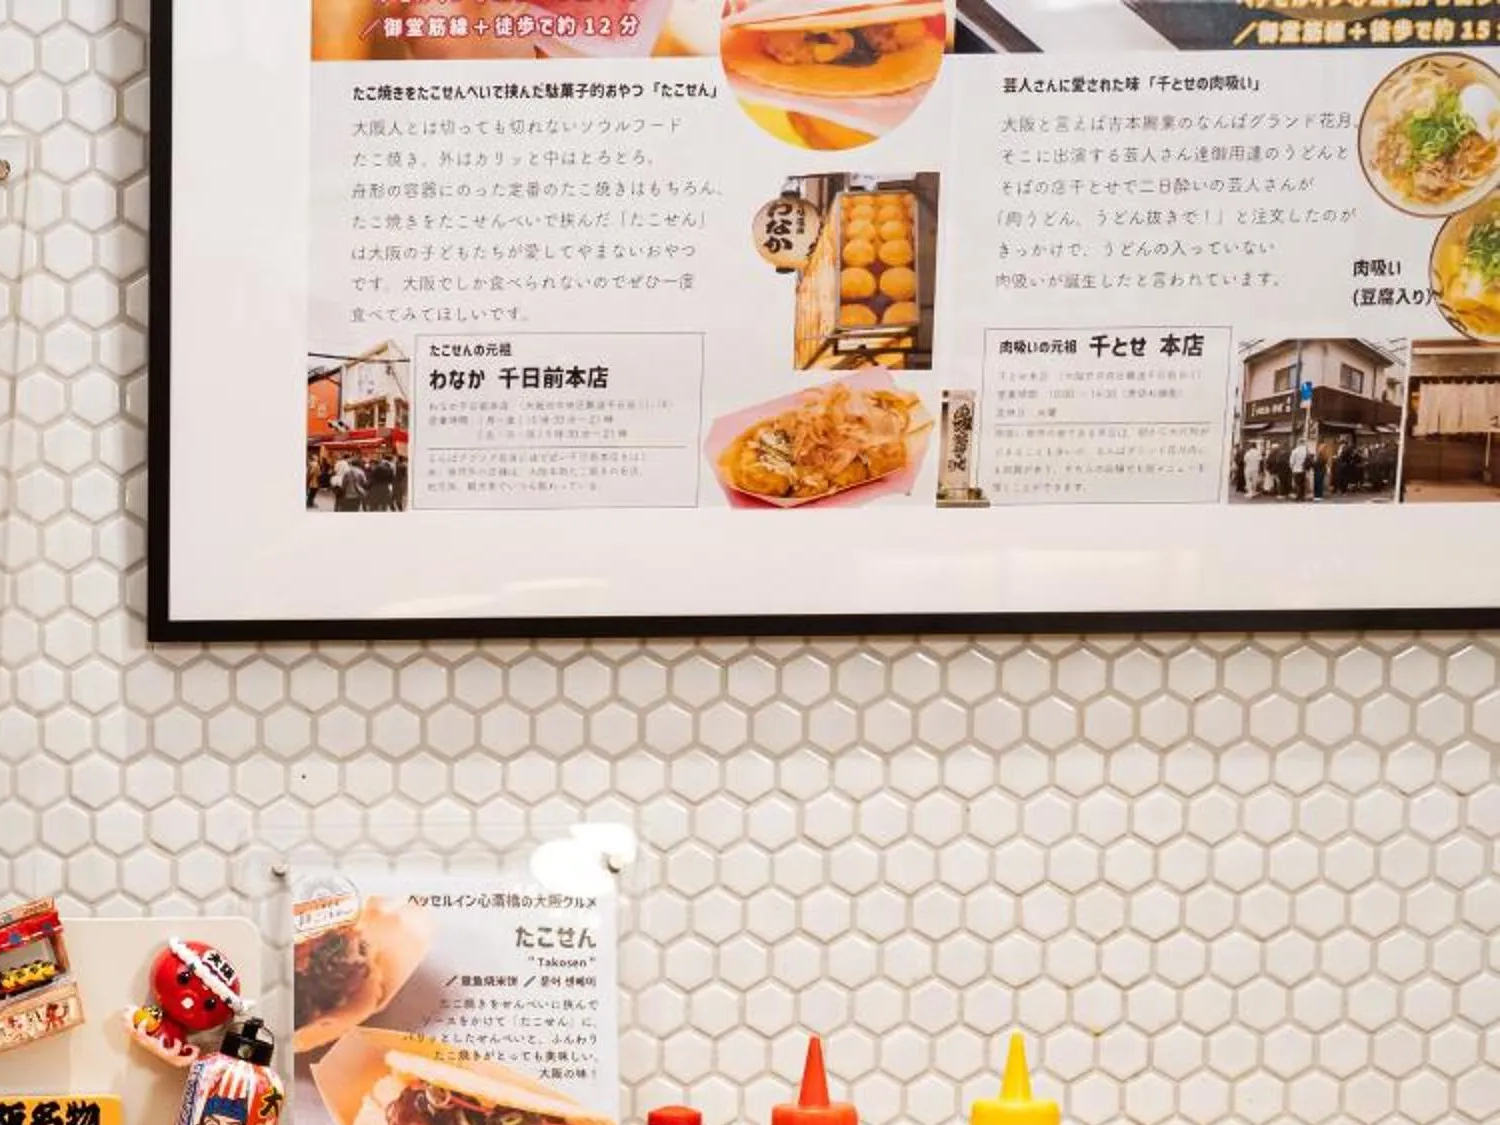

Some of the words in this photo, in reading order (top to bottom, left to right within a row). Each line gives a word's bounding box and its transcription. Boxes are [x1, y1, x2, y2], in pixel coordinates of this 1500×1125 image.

[584, 17, 612, 36] 12
[620, 15, 641, 36] 分
[1460, 19, 1491, 41] 15
[1353, 259, 1401, 277] 肉吸い
[429, 343, 512, 357] たこせんの元祖
[999, 339, 1077, 355] 肉吸いの元祖
[1089, 335, 1147, 358] 千とせ
[1160, 334, 1205, 357] 本店
[429, 367, 485, 391] わなか
[498, 366, 609, 390] 千日前本店
[515, 925, 597, 949] たこせん
